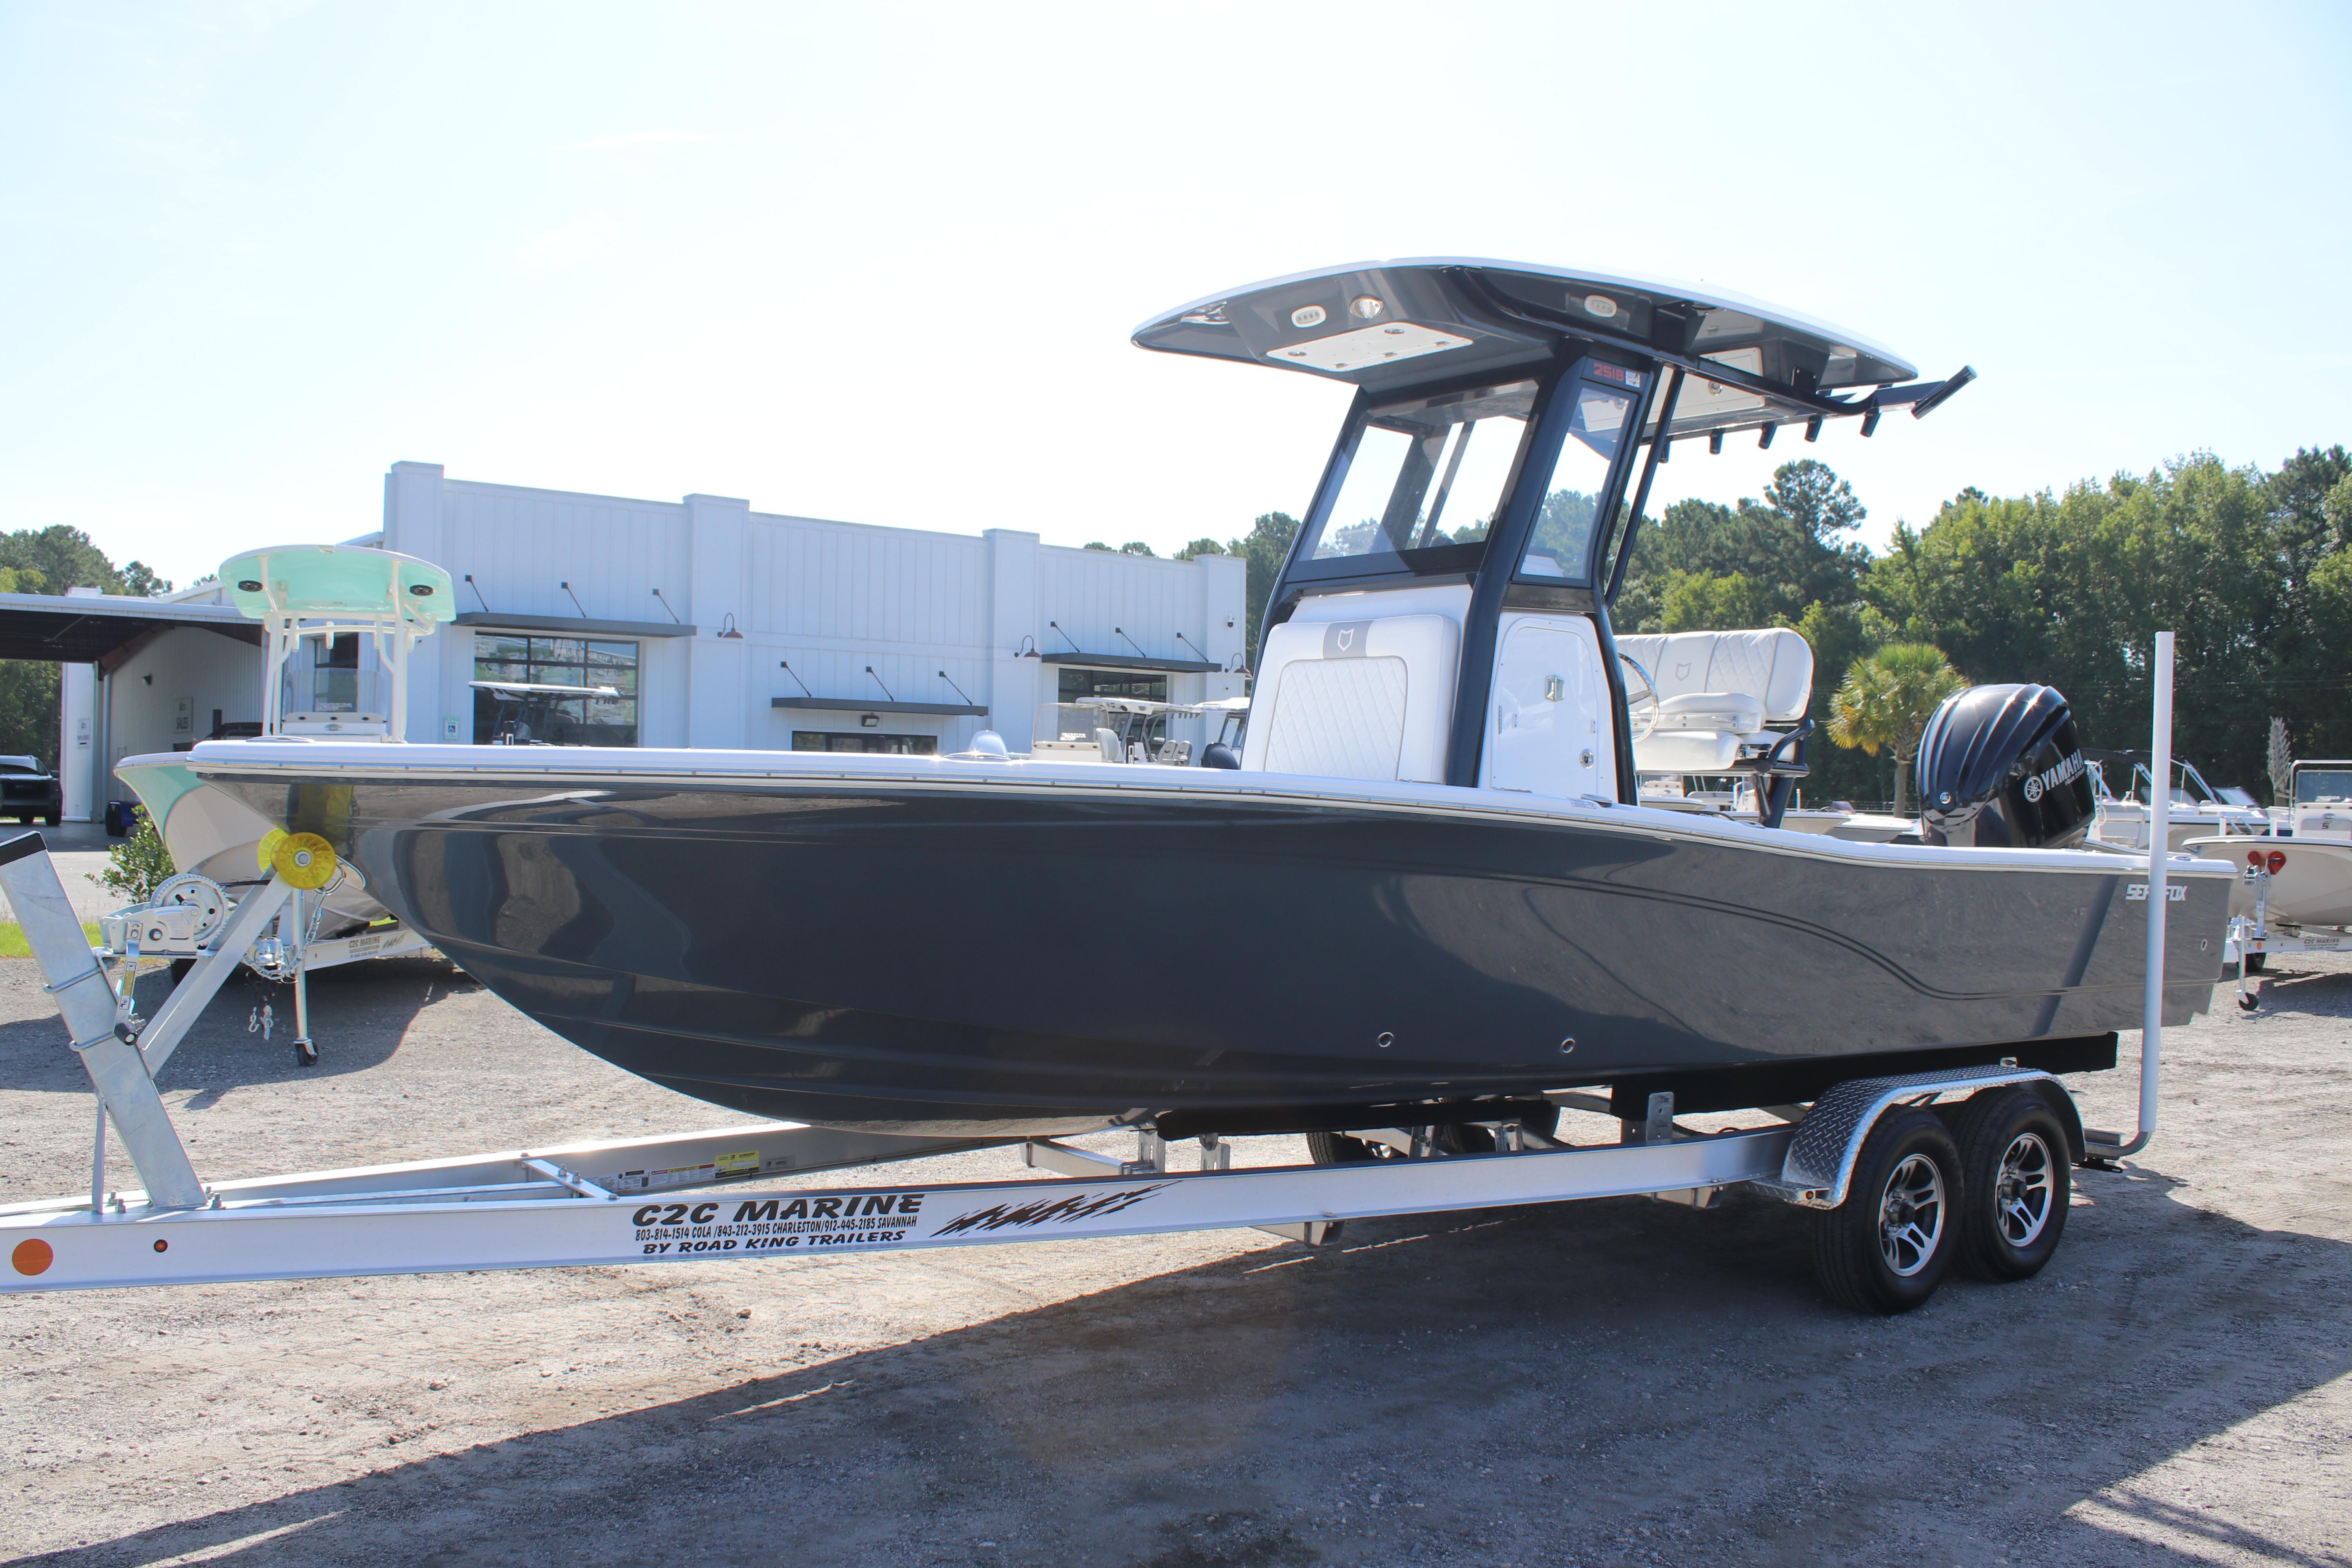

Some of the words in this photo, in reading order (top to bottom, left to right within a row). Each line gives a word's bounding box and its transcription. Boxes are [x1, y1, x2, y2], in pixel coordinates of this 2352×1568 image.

[2040, 748, 2084, 791] YAMAHA
[349, 940, 359, 948] C2C
[360, 936, 381, 946] MARINE
[633, 1203, 719, 1226] C2C
[733, 1194, 925, 1222] MARINE
[635, 1226, 689, 1241] 803-814-1514
[692, 1225, 711, 1238] COLA
[713, 1223, 770, 1239] /843-212-3915
[773, 1218, 875, 1234] CHARLESTON/912-445-2185
[877, 1216, 917, 1229] SAVANNAH
[643, 1243, 671, 1254] BY
[678, 1240, 737, 1253] ROAD
[745, 1236, 799, 1250] KING
[808, 1230, 906, 1245] TRAILERS
